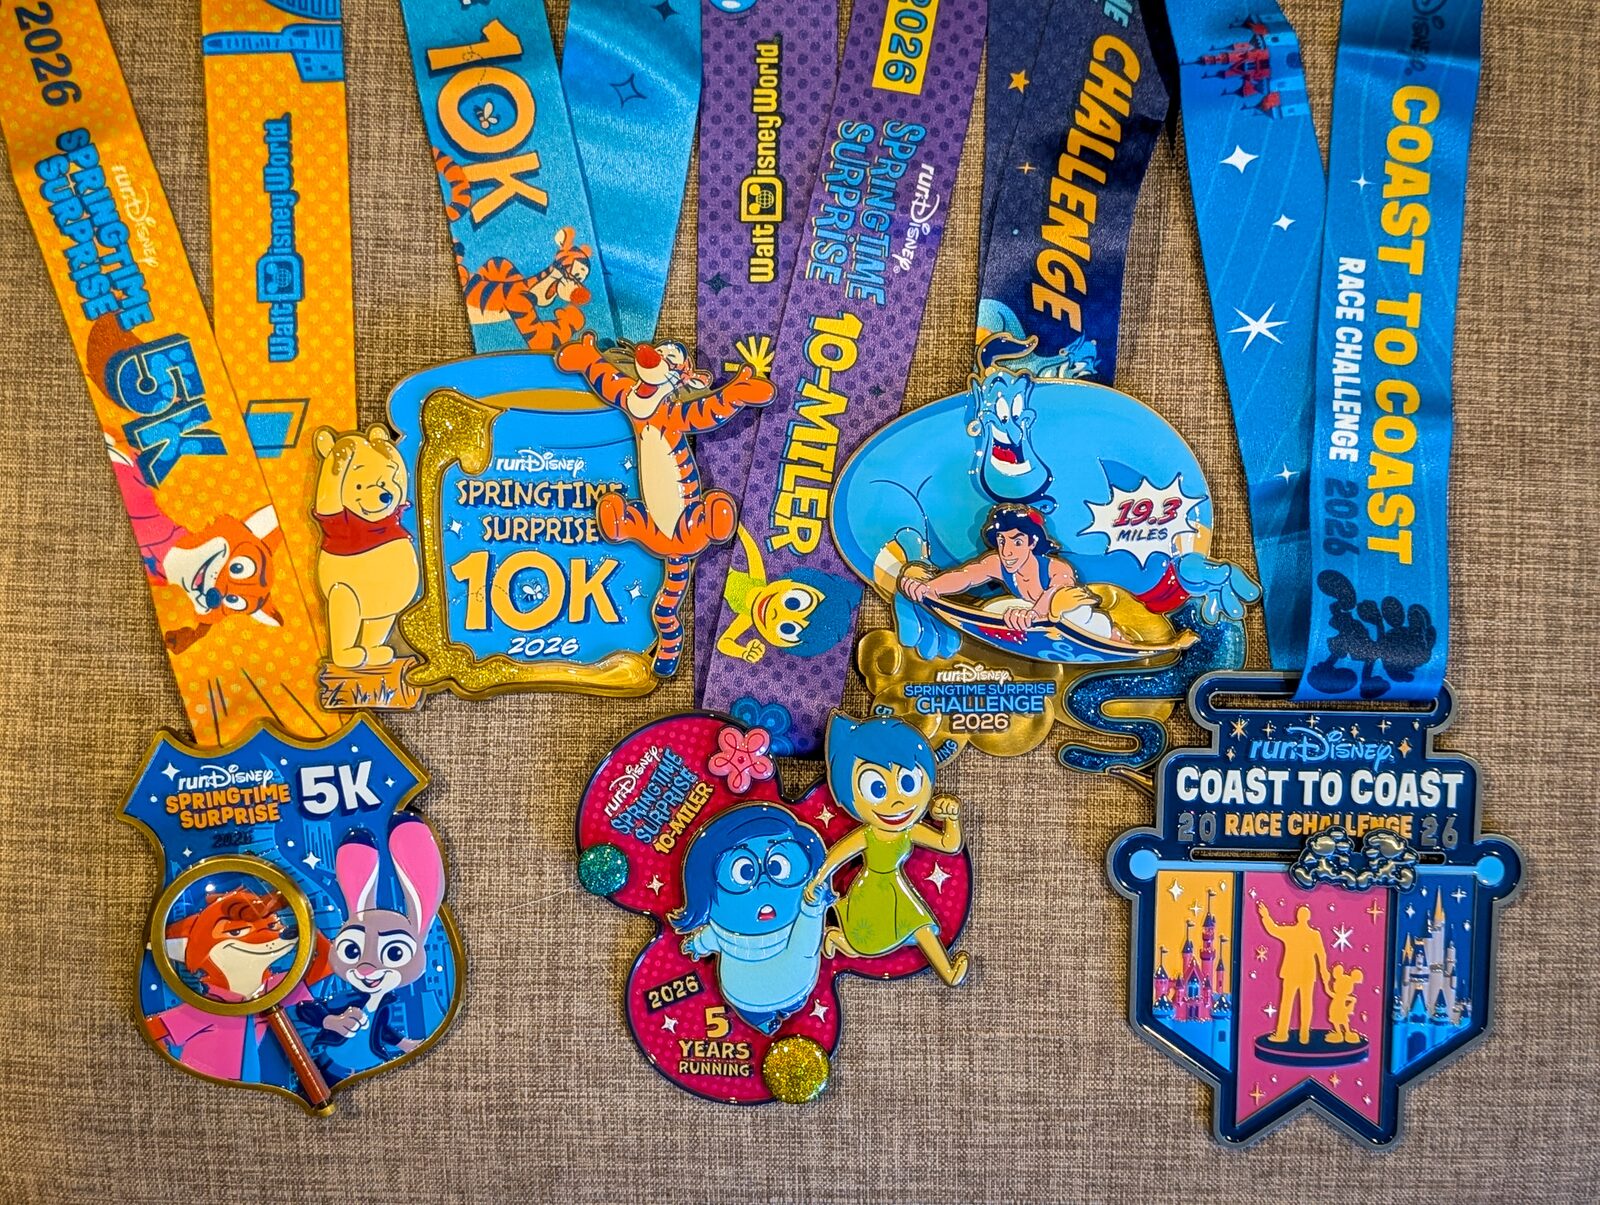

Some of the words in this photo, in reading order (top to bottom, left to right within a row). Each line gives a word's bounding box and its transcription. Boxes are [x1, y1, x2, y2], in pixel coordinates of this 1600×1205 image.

[15, 2, 82, 107] 2026
[753, 43, 781, 114] World
[883, 0, 932, 84] 026
[263, 116, 294, 192] World
[426, 19, 549, 225] 10K
[741, 114, 784, 223] Disney
[806, 120, 876, 285] SURPRISE
[1031, 35, 1141, 333] CHALLENGE
[1377, 85, 1441, 276] COAST
[35, 154, 117, 321] SURPRISE
[56, 127, 155, 331] SPRINGTIME
[256, 191, 304, 303] Disney
[846, 119, 928, 305] SPRINGTIME
[749, 224, 776, 284] Walt
[1336, 256, 1366, 322] RACE
[268, 302, 299, 362] Walt
[1373, 293, 1422, 366] TO
[104, 333, 228, 490] 5K
[1328, 322, 1364, 462] CHALLENGE
[765, 311, 864, 555] 10-MILER
[1367, 379, 1421, 565] COAST
[482, 515, 600, 544] SURPRISE
[1113, 497, 1182, 527] 19.3
[1117, 528, 1168, 541] MILES
[1323, 477, 1359, 556] 2026
[451, 550, 619, 632] 10K
[507, 637, 580, 657] 2026
[904, 684, 987, 697] SPRINGTIME
[989, 683, 1056, 695] SURPRISE
[916, 696, 1044, 714] CHALLENGE
[952, 713, 1009, 730] 2026
[166, 783, 292, 815] SPRINGTIME
[180, 802, 281, 829] SURPRISE
[298, 760, 382, 817] 5K
[610, 748, 683, 835] SPRINGTIME
[635, 768, 699, 844] SURPRISE
[653, 782, 714, 855] 10-MILER
[1176, 767, 1289, 805] COAST
[1298, 769, 1343, 806] TO
[1351, 769, 1464, 808] COAST
[1178, 813, 1217, 842] 20
[1224, 813, 1283, 836] RACE
[1421, 817, 1459, 848] 26
[649, 976, 699, 1009] 2026
[705, 1007, 730, 1038] 5
[678, 1040, 750, 1059] YEARS
[679, 1061, 750, 1077] RUNNING
